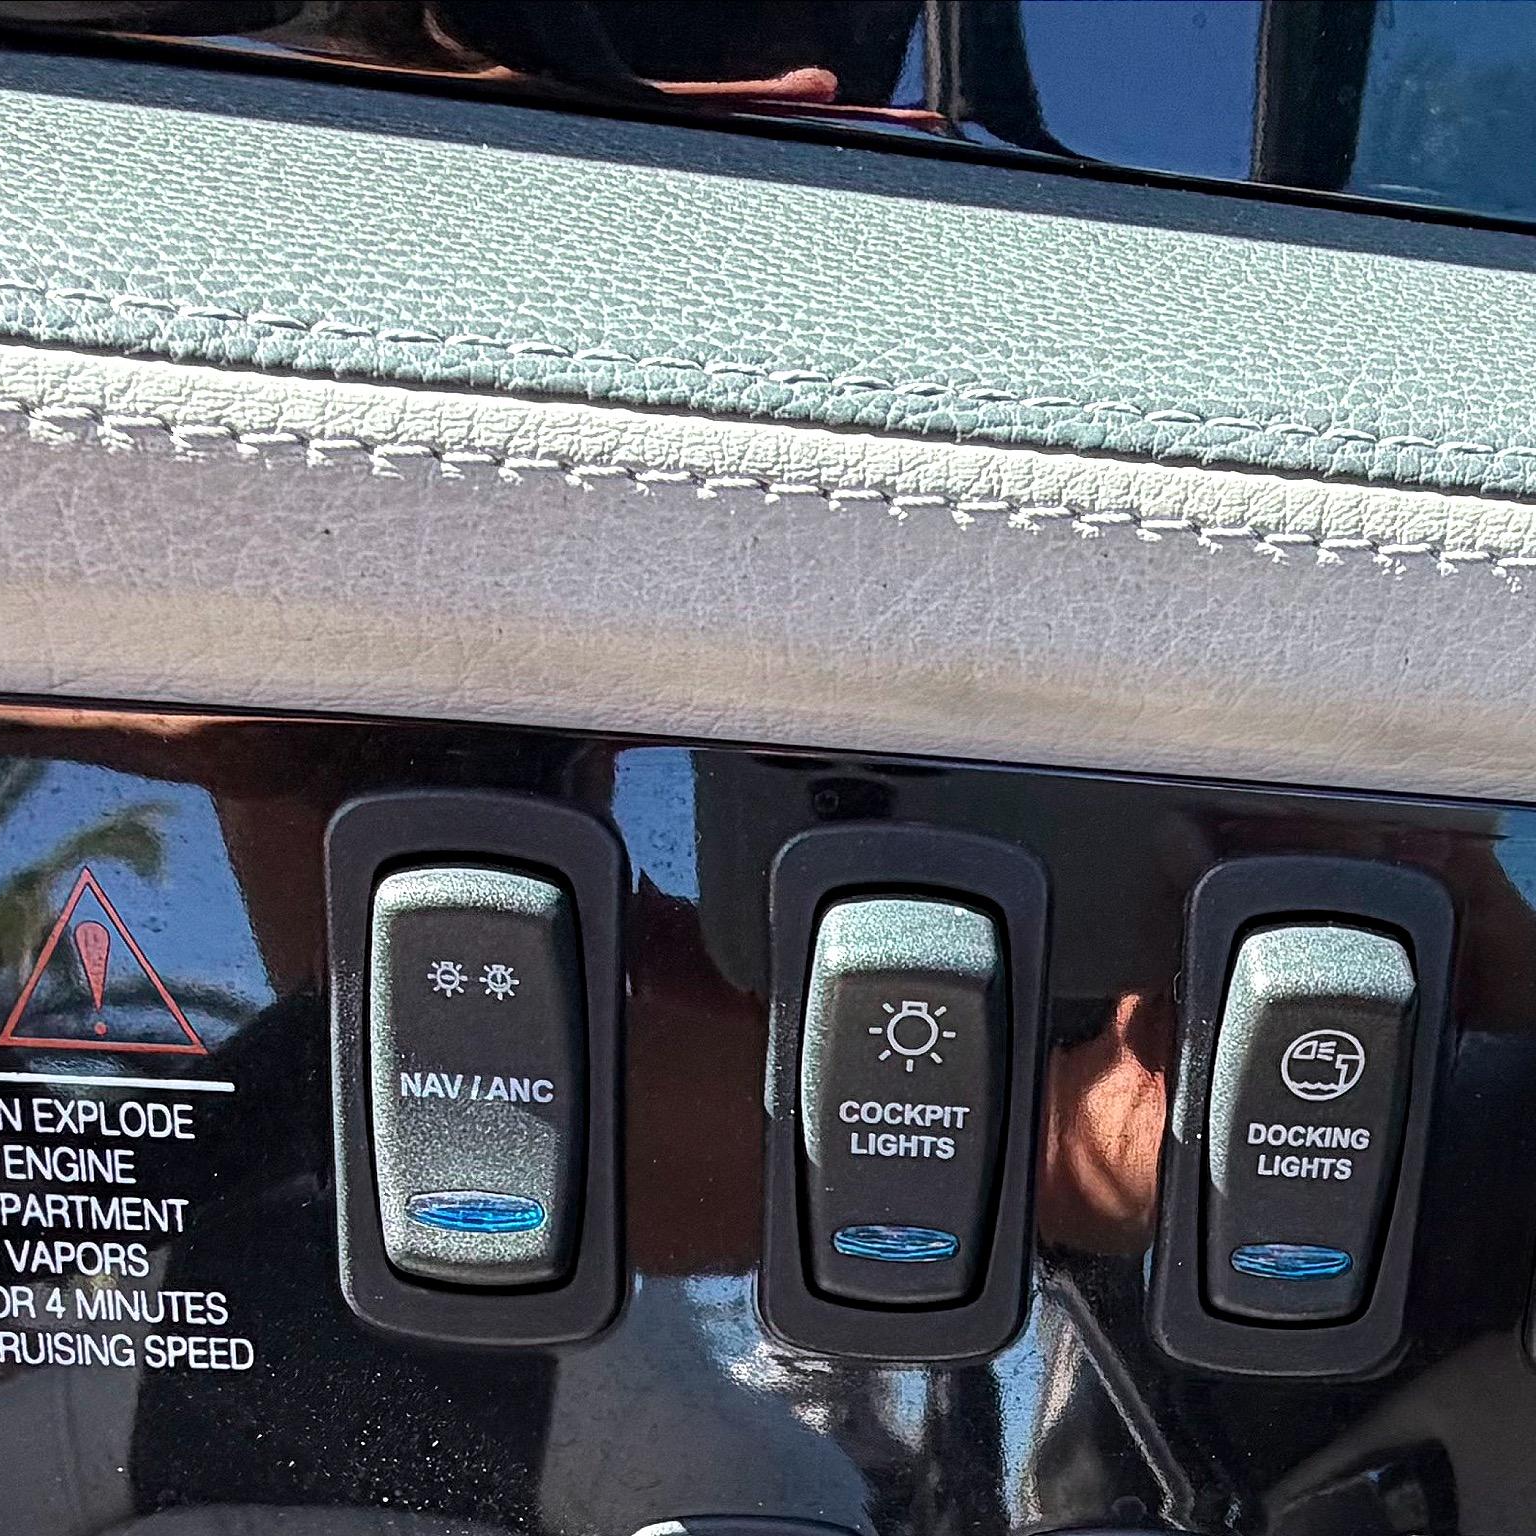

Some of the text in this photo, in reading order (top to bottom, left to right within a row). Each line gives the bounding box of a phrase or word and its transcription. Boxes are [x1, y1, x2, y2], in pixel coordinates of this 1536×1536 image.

[32, 1098, 196, 1139] EXPLODE
[838, 1100, 970, 1129] COCKPIT
[850, 1132, 955, 1160] LIGHTS
[1247, 1122, 1370, 1150] DOCKING
[3, 1144, 137, 1184] ENGINE
[1257, 1154, 1352, 1180] LIGHTS
[4, 1239, 150, 1277] VAPORS
[45, 1287, 67, 1320] 4
[75, 1288, 229, 1325] MINUTES
[144, 1334, 254, 1370] SPEED
